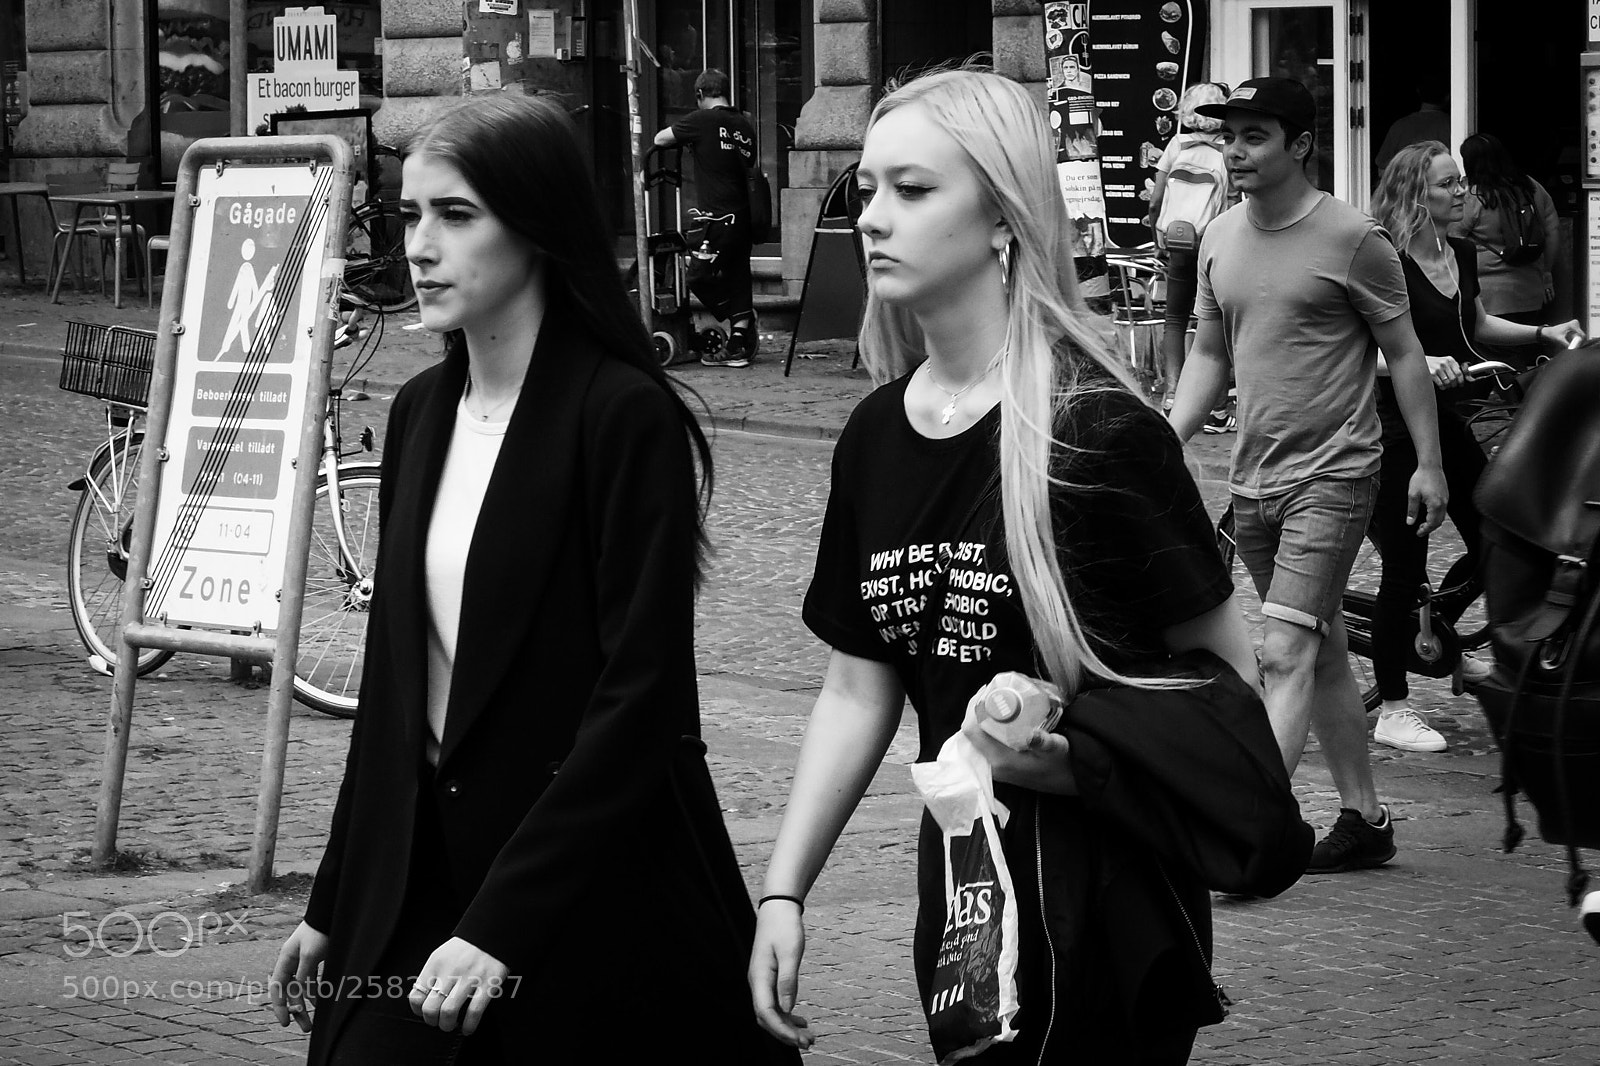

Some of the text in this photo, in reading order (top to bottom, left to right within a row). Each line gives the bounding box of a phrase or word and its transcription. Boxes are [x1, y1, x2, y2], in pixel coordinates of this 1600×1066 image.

[276, 24, 334, 62] UMAMI
[258, 76, 356, 101] Et bacon burger
[229, 202, 296, 229] Gågade
[259, 391, 287, 403] tilladt
[248, 441, 276, 454] tilladt
[870, 547, 905, 572] WHY
[908, 543, 934, 564] BE
[179, 565, 251, 605] Zone
